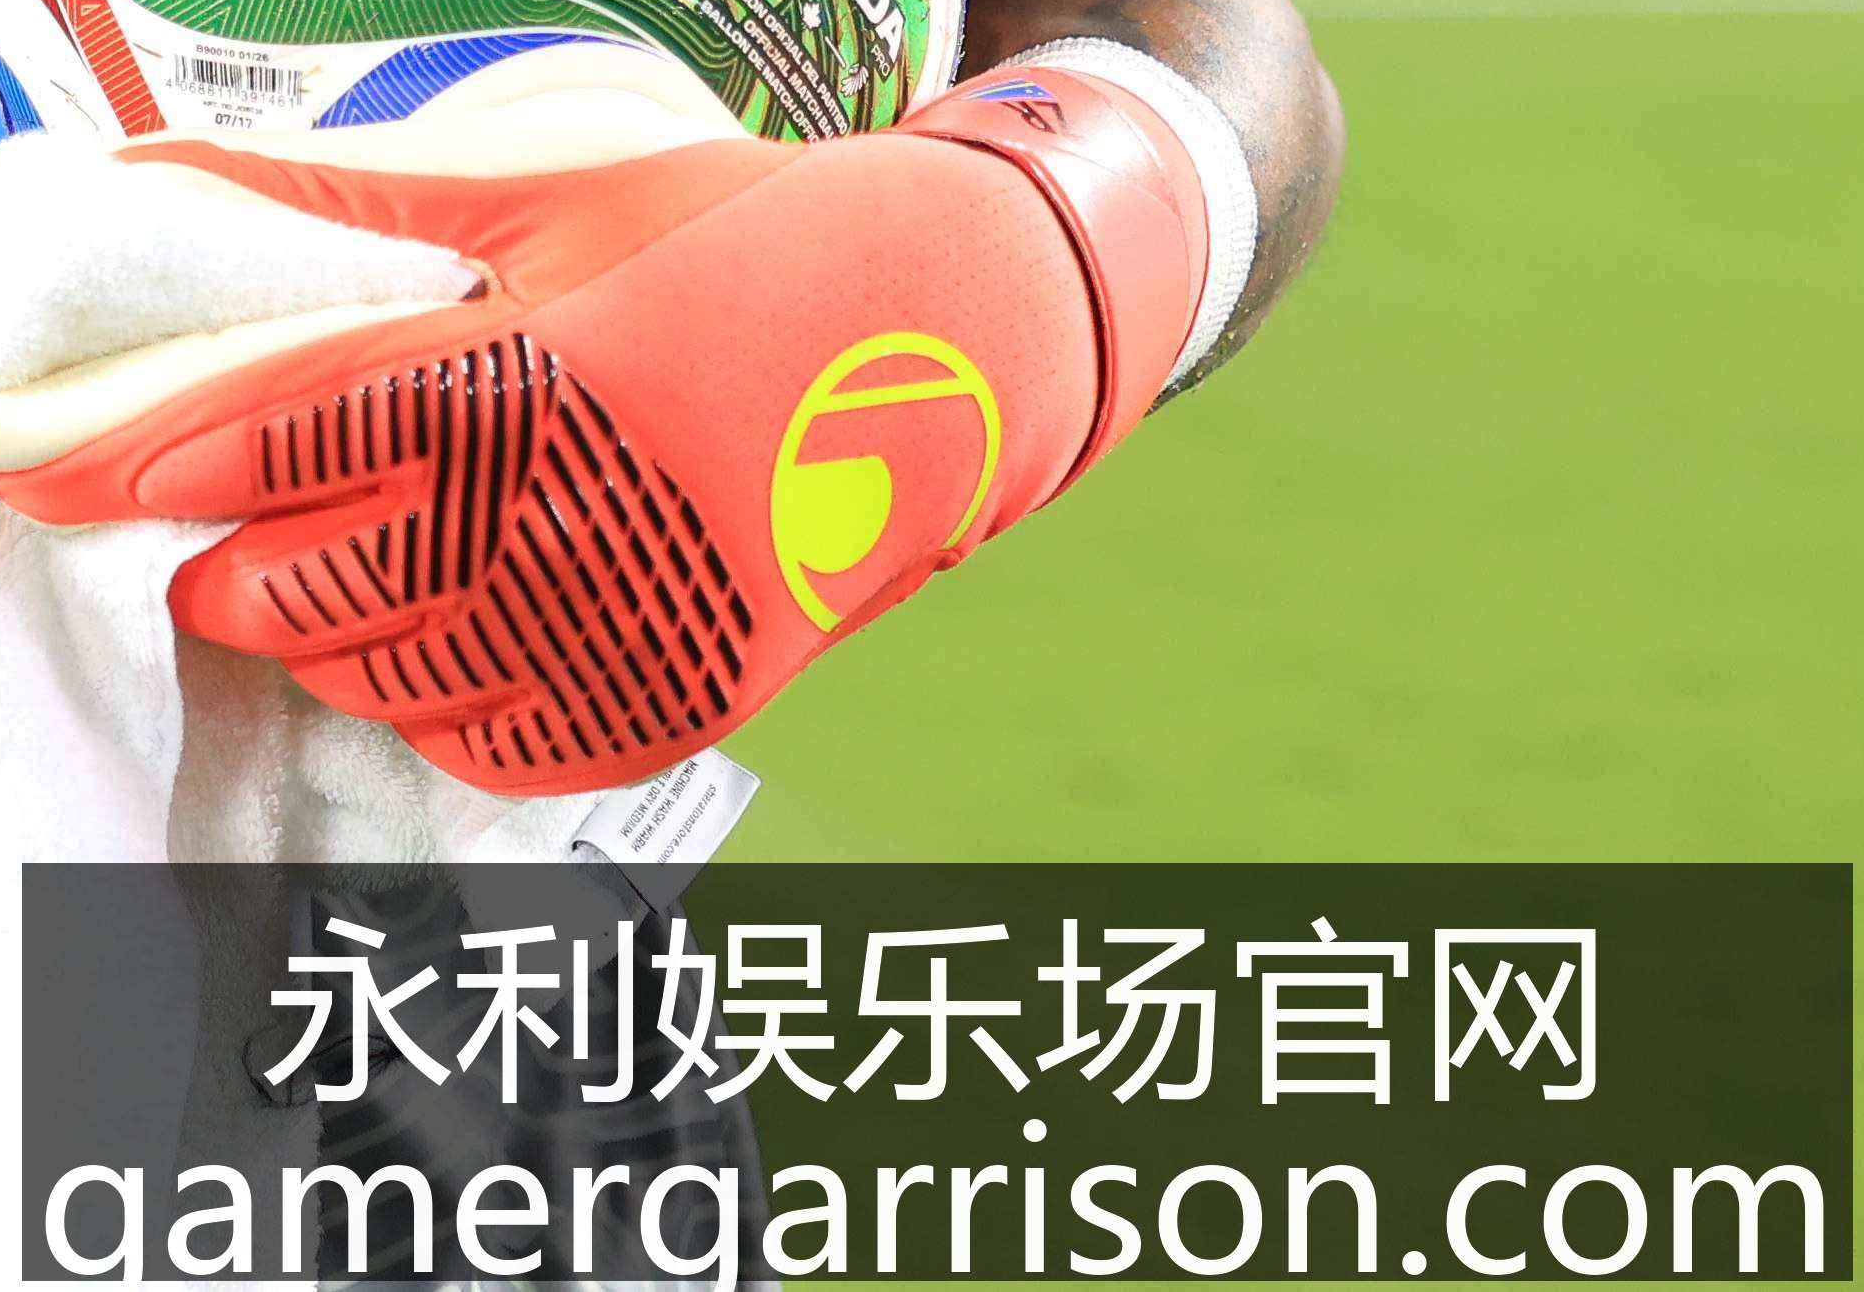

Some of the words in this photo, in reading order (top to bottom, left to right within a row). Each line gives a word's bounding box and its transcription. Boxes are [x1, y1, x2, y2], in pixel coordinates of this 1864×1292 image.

[196, 44, 236, 58] B90010
[238, 49, 270, 63] 01/26
[700, 0, 751, 55] BALLON
[748, 48, 766, 72] DE
[762, 64, 798, 114] MATCH
[743, 19, 792, 78] OFFICIAL
[788, 72, 823, 121] MATCH
[870, 43, 891, 78] PRO
[764, 14, 804, 65] OFICIAL
[802, 60, 820, 88] DEL
[817, 83, 848, 135] PARTIDO
[671, 759, 700, 801] MACHINE
[652, 797, 675, 827] WASH
[630, 823, 657, 854] WARM
